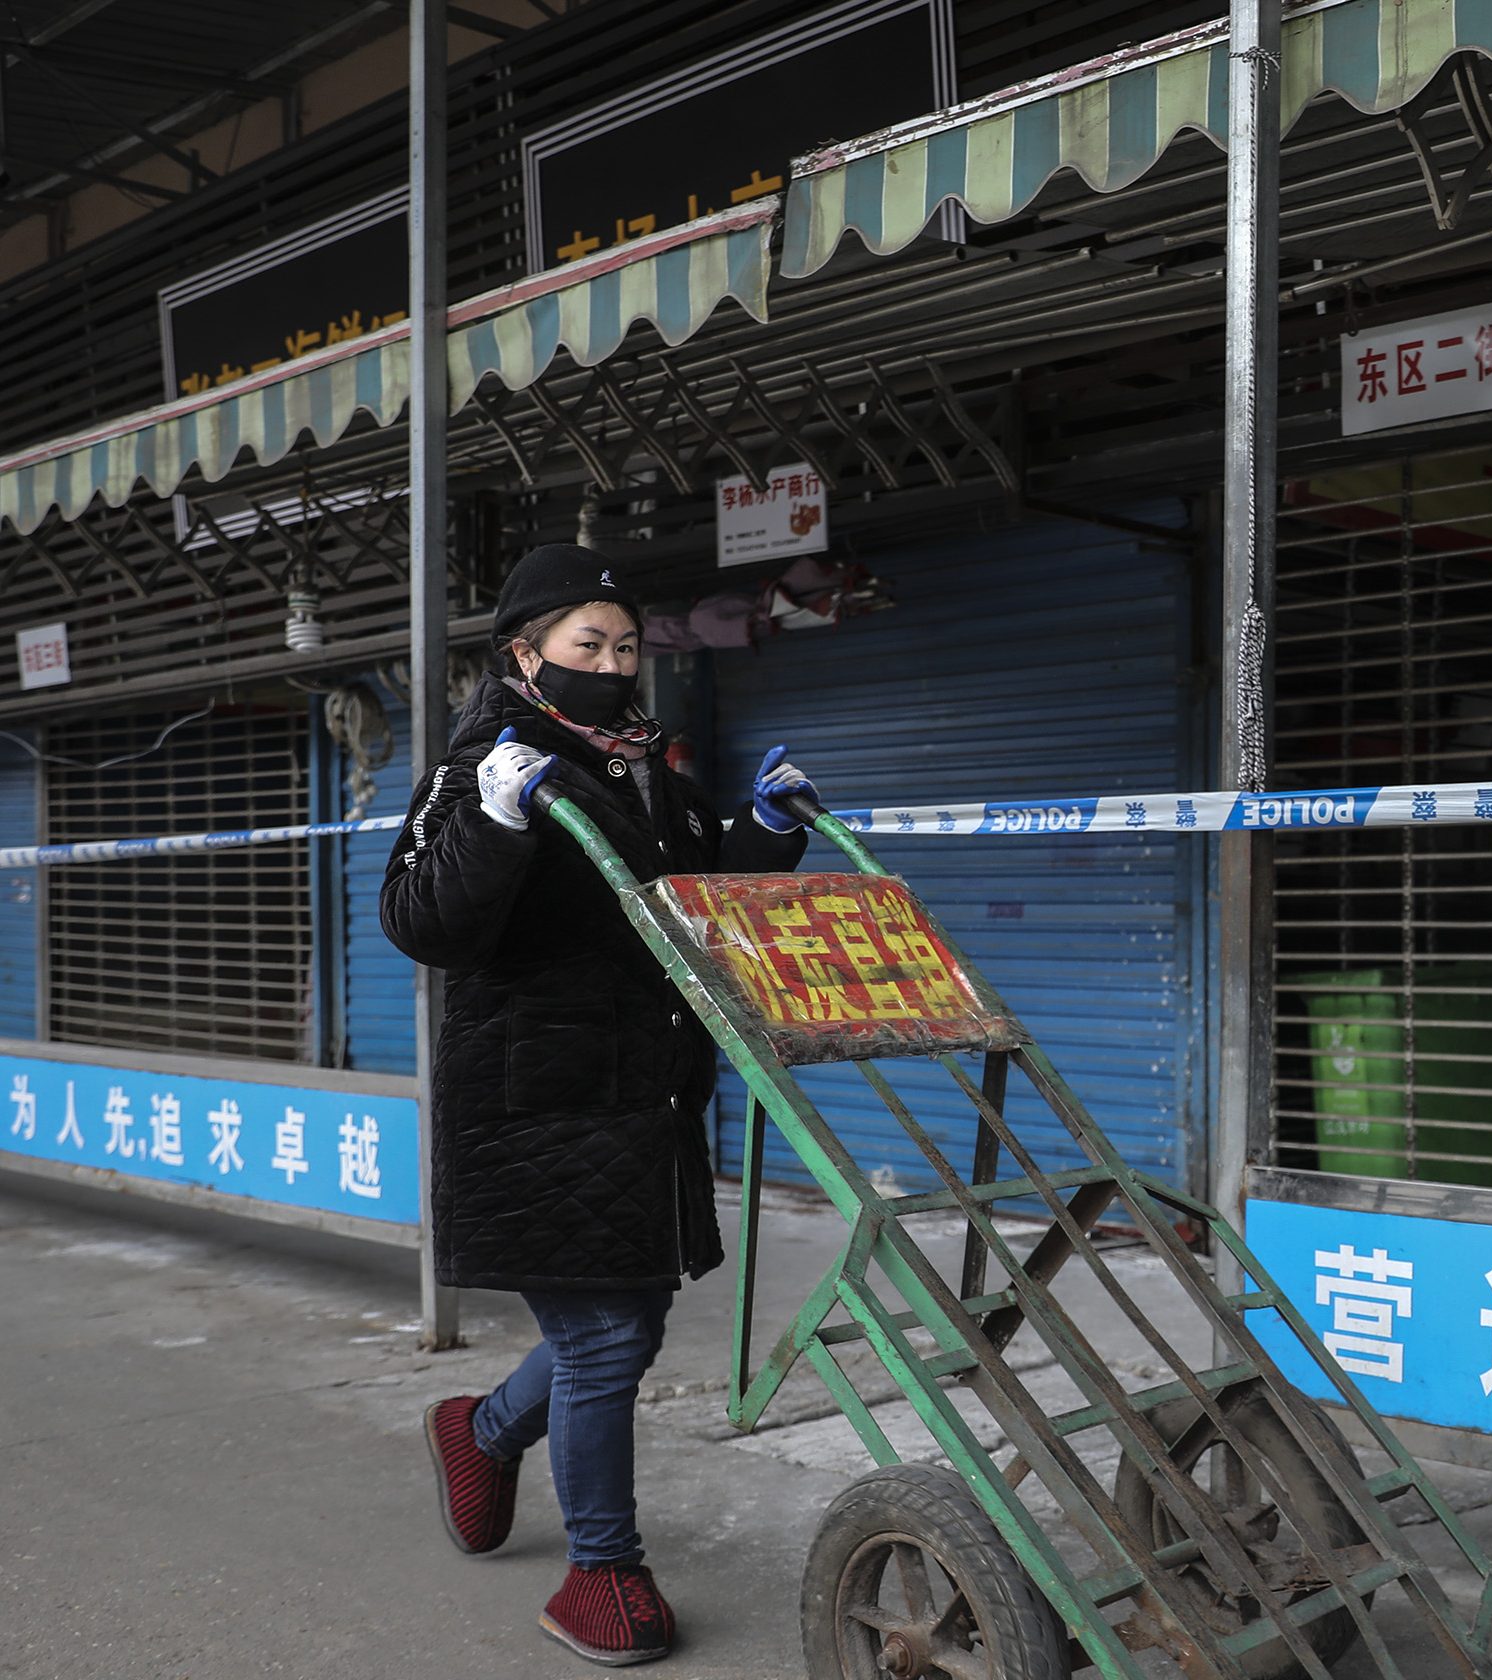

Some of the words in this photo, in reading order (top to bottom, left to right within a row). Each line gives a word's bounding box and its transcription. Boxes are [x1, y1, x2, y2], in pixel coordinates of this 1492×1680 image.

[989, 804, 1084, 833] POLICE
[1124, 800, 1198, 830] 警察
[1242, 795, 1356, 828] POLICE
